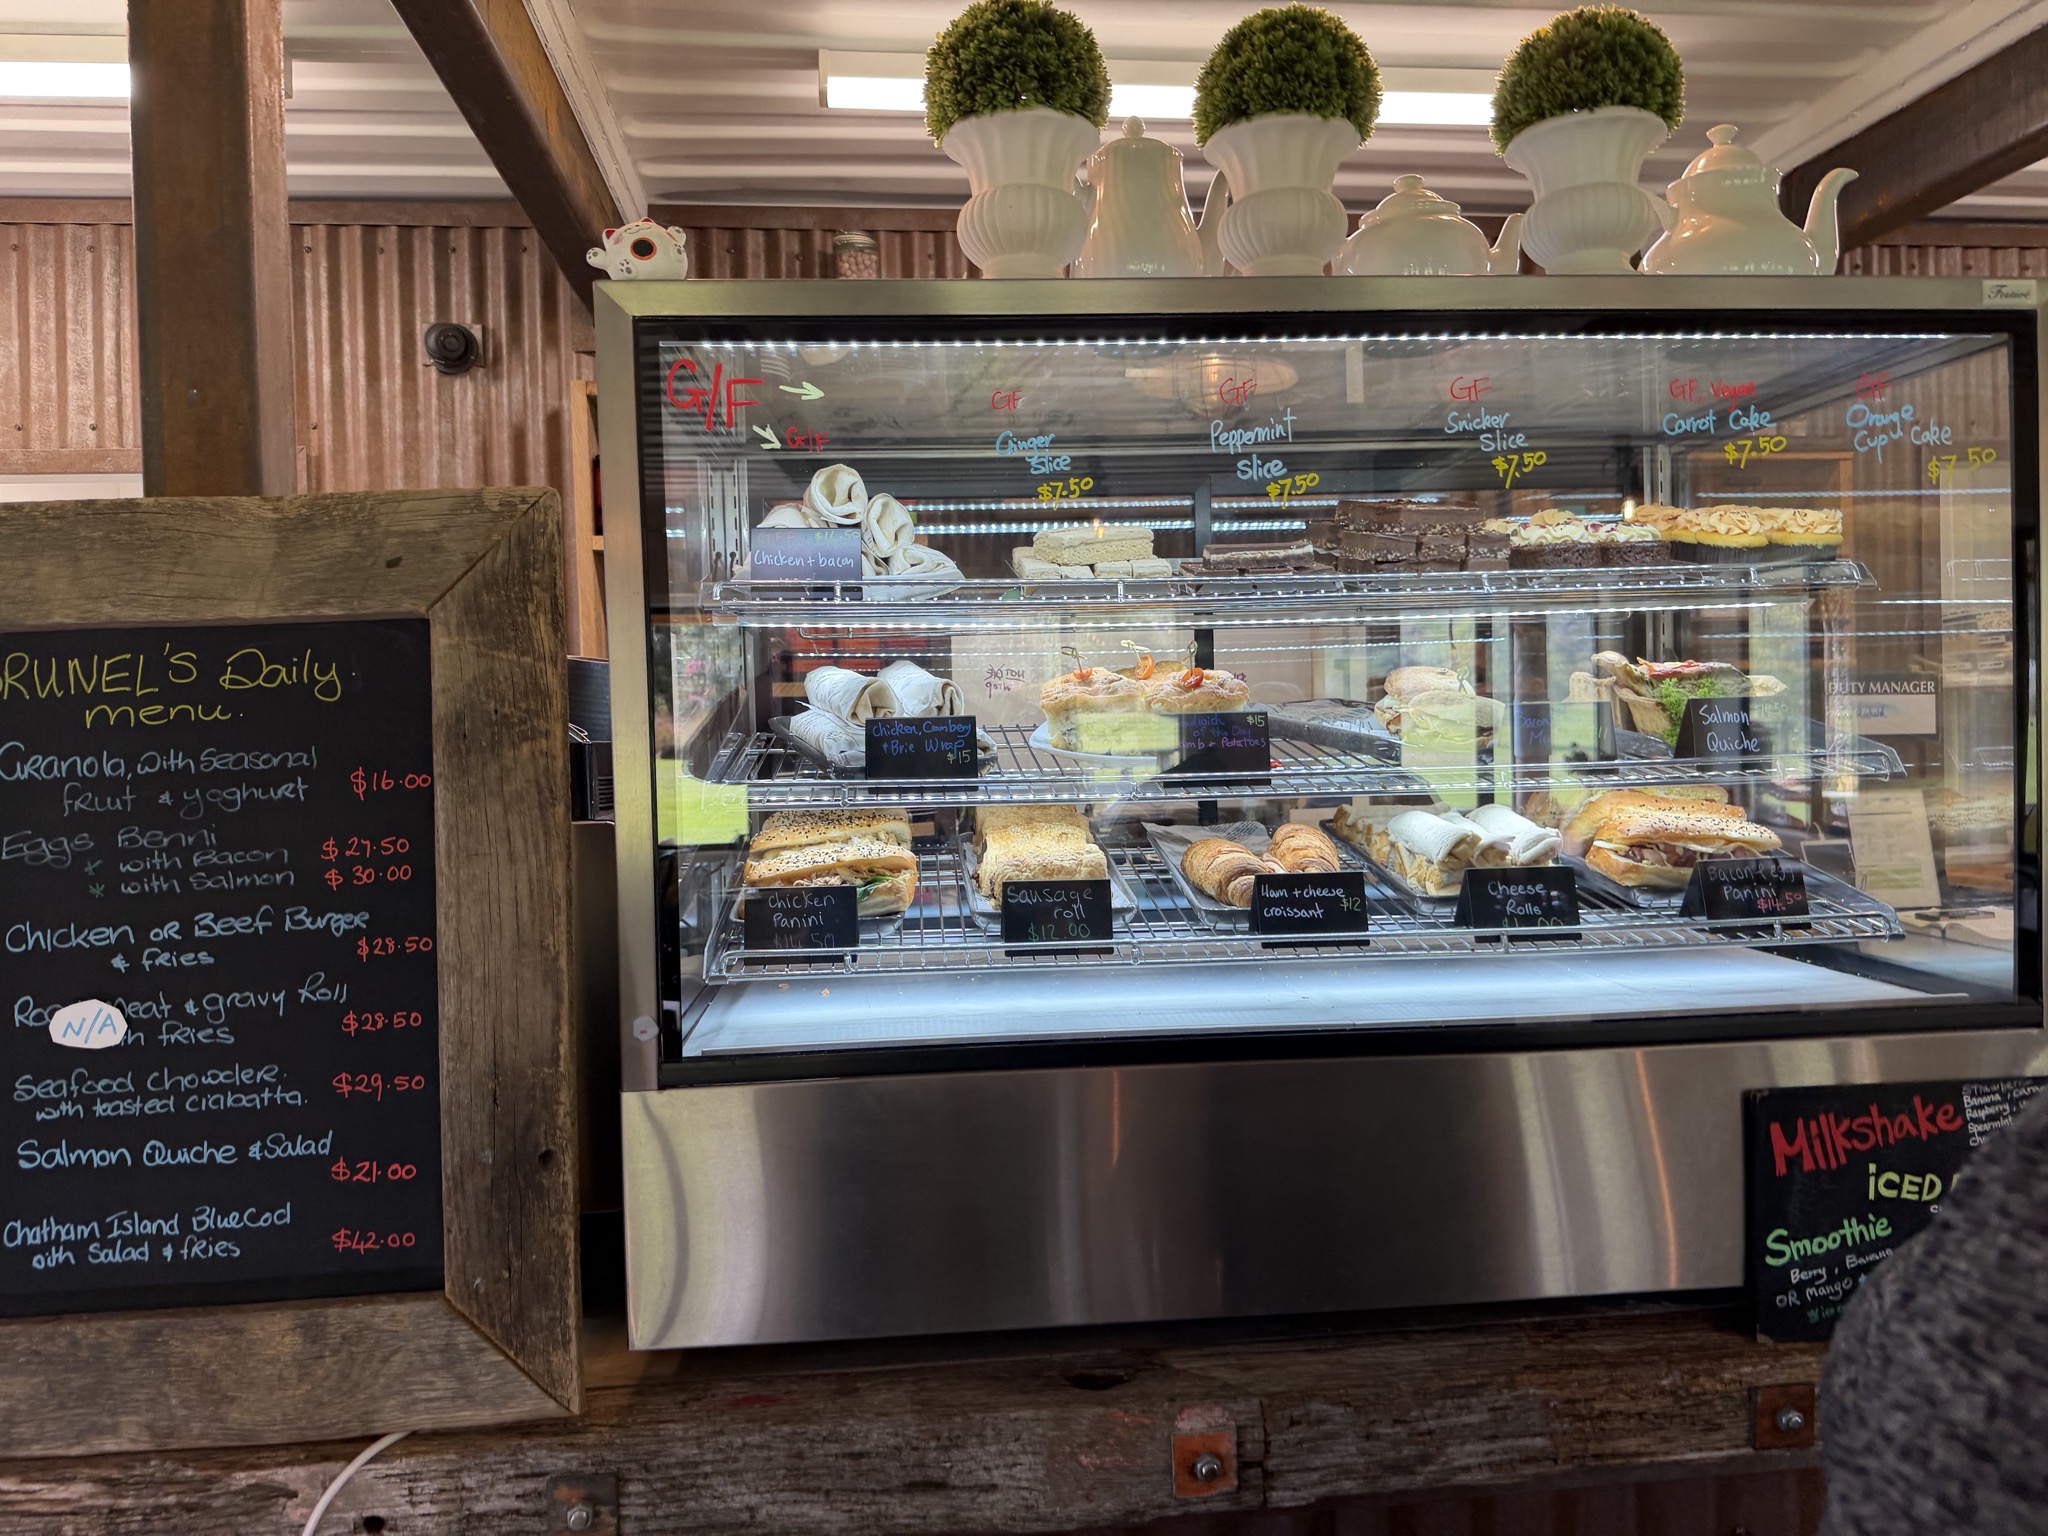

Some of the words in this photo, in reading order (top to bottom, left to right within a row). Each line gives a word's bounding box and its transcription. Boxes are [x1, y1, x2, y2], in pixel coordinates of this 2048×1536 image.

[666, 358, 765, 431] G/F
[991, 389, 1023, 411] GF
[1220, 377, 1258, 405] GF
[1450, 376, 1494, 403] GF
[1710, 378, 1757, 412] Vegan
[1856, 371, 1892, 402] GF
[1210, 407, 1298, 455] Peppermint
[1444, 407, 1511, 434] Snicker
[1662, 408, 1717, 436] Carrot
[1728, 404, 1778, 432] Cake
[1845, 404, 1915, 440] Orange
[786, 426, 830, 453] G/F
[995, 430, 1056, 462] Ginger
[1723, 436, 1787, 469] $7.50
[1853, 430, 1890, 464] Cup
[1037, 476, 1094, 511] $7.50
[1265, 472, 1320, 510] $7.50
[754, 549, 805, 567] Chicken
[807, 556, 816, 567] +
[818, 552, 854, 568] bacon
[0, 642, 199, 700] RUNEL'S
[1828, 681, 1866, 694] DUTY
[1868, 681, 1936, 694] MANAGER
[1246, 714, 1265, 727] $15
[1699, 704, 1750, 726] Salmon
[1180, 737, 1205, 750] amb
[1193, 727, 1207, 737] of
[1231, 725, 1251, 738] Day
[1706, 731, 1760, 753] Quiche
[890, 738, 916, 757] Brie
[946, 750, 971, 764] $15
[350, 765, 432, 801] $16.00
[1, 830, 95, 869] Eggs
[117, 823, 217, 849] Benni
[119, 850, 182, 873] with
[193, 848, 289, 868] Bacon
[1707, 865, 1753, 882] Bacon
[1769, 865, 1795, 883] egg
[120, 873, 181, 895] with
[1007, 885, 1093, 906] Sausage
[1261, 884, 1288, 899] Ham
[1292, 886, 1302, 898] +
[1303, 884, 1346, 899] cheese
[1487, 880, 1546, 896] Cheese
[1722, 882, 1777, 900] Panini
[1053, 903, 1086, 920] roll
[1263, 902, 1325, 919] croissant
[1340, 896, 1361, 912] $12
[1505, 899, 1542, 915] Rolls
[5, 920, 135, 953] Chicken
[194, 904, 274, 938] Beef
[773, 911, 825, 929] Panini
[1028, 922, 1091, 942] $12.00
[357, 935, 434, 963] $28.50
[202, 988, 286, 1025] gravy
[62, 1007, 118, 1044] N/A
[341, 1009, 423, 1038] $28.50
[13, 1067, 135, 1102] Seafood
[332, 1071, 426, 1102] $29.50
[35, 1100, 84, 1122] with
[92, 1094, 176, 1118] toasted
[1770, 1093, 1965, 1178] Milkshake
[17, 1138, 132, 1169] Salmon
[143, 1139, 238, 1167] Quiche
[331, 1156, 417, 1183] $21.00
[3, 1215, 101, 1248] Chatham
[105, 1210, 180, 1239] Island
[332, 1227, 417, 1255] $42.00
[1765, 1212, 1892, 1267] Smoothie
[88, 1239, 150, 1264] Salad
[1776, 1289, 1801, 1308] OR
[1805, 1277, 1854, 1301] Mango
